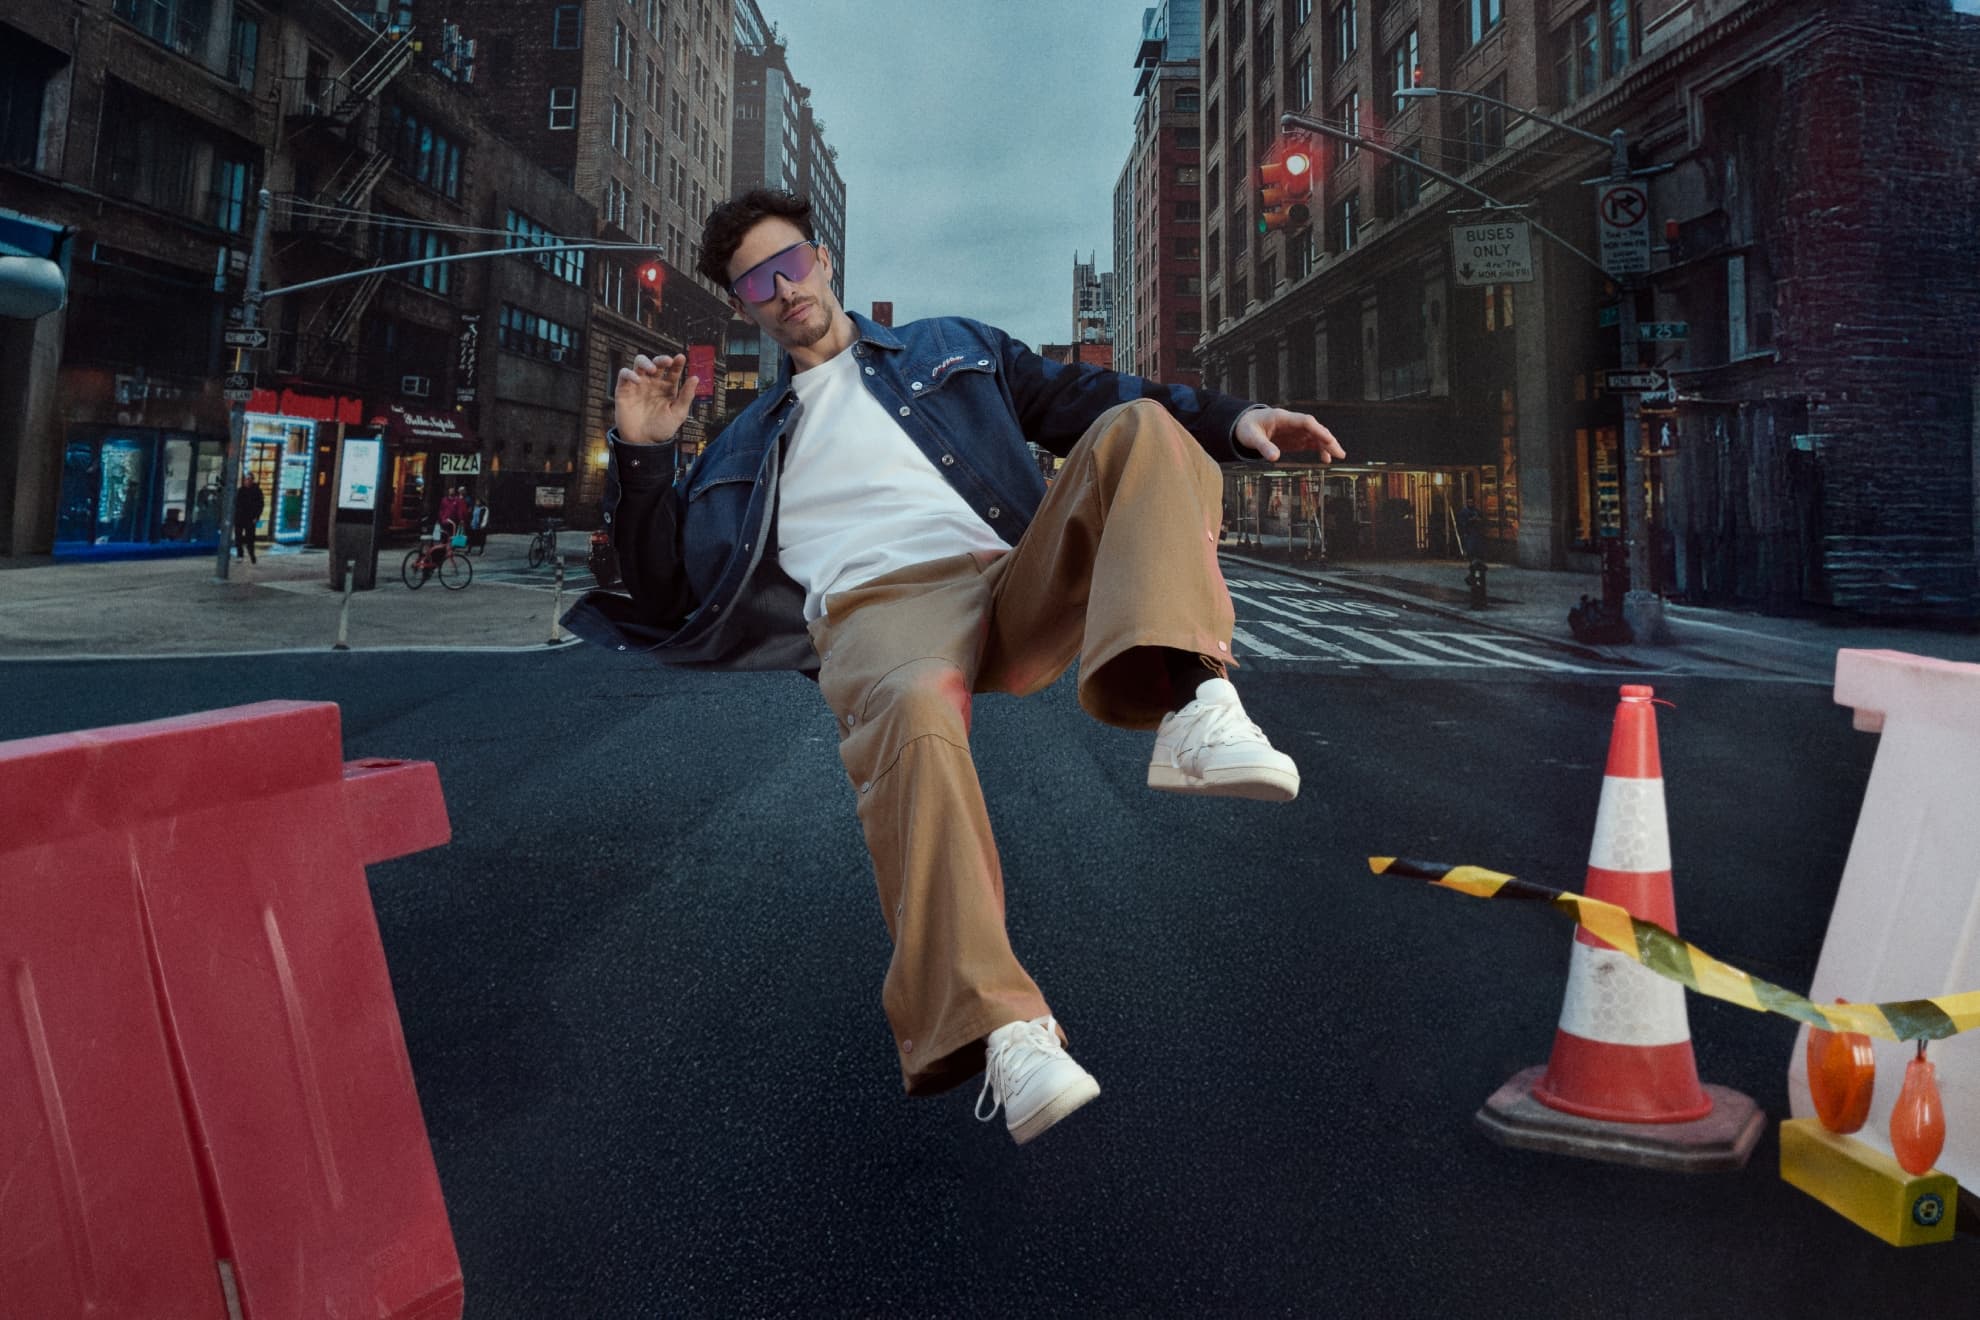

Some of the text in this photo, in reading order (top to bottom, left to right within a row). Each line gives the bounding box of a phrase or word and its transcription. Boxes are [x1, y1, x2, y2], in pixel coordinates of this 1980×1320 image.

[1466, 227, 1514, 242] BUSES
[1473, 244, 1511, 258] ONLY
[1640, 326, 1651, 338] W
[1656, 326, 1673, 338] 25
[440, 455, 479, 471] PIZZA
[1268, 596, 1399, 617] BUS
